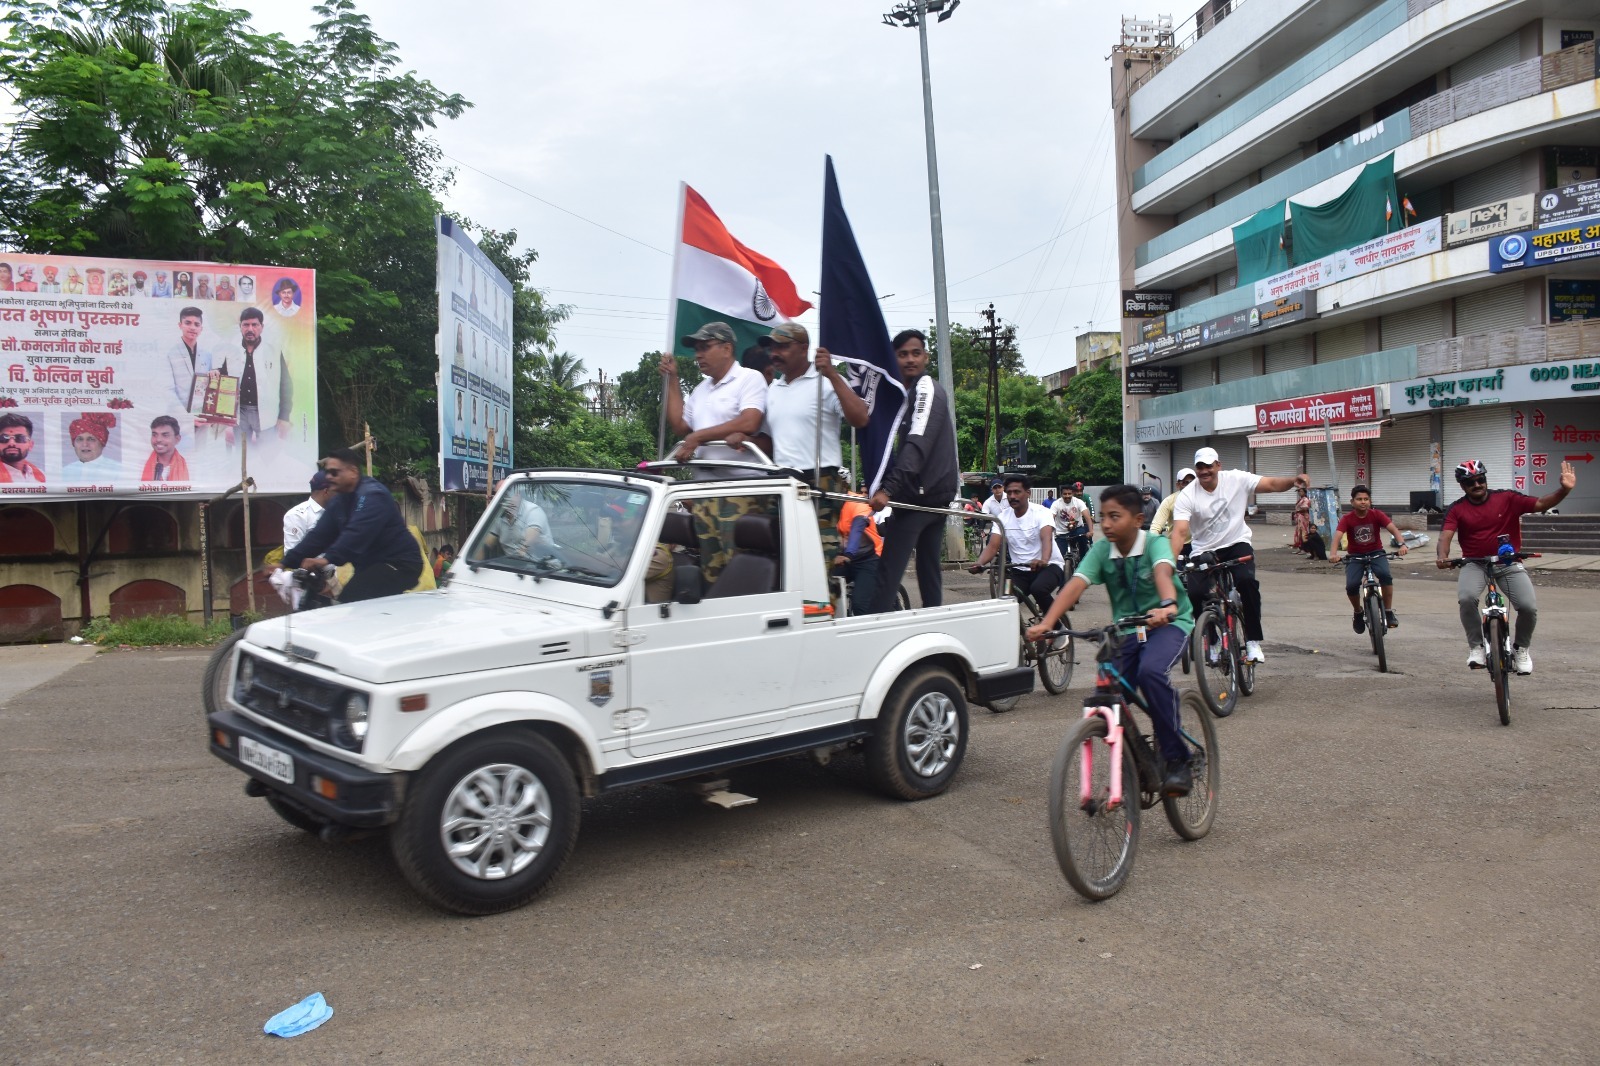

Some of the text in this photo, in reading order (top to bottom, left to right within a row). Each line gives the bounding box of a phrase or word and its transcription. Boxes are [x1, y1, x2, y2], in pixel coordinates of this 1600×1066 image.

[1470, 220, 1508, 234] SHOPPEE
[1532, 228, 1582, 248] महाराष्ट्र
[1355, 251, 1379, 266] रणधीर
[1381, 240, 1416, 258] सावरकर
[1567, 243, 1590, 252] MPSC
[27, 299, 57, 307] शहराच्या
[98, 302, 119, 310] दिल्ली
[1126, 299, 1146, 311] स्किन
[30, 309, 74, 328] भूषण
[77, 311, 140, 330] पुरस्कार
[61, 329, 88, 338] सेविका
[79, 339, 101, 354] कौर
[104, 340, 123, 355] ताई
[27, 355, 95, 366] युवा समाज सेवक
[8, 364, 114, 388] चि. केल्विन सुबी
[1530, 365, 1569, 381] GOOD
[1405, 385, 1425, 405] गुड
[1458, 369, 1504, 393] फार्मा
[1270, 399, 1346, 425] रुग्णसेवा मेडिकल
